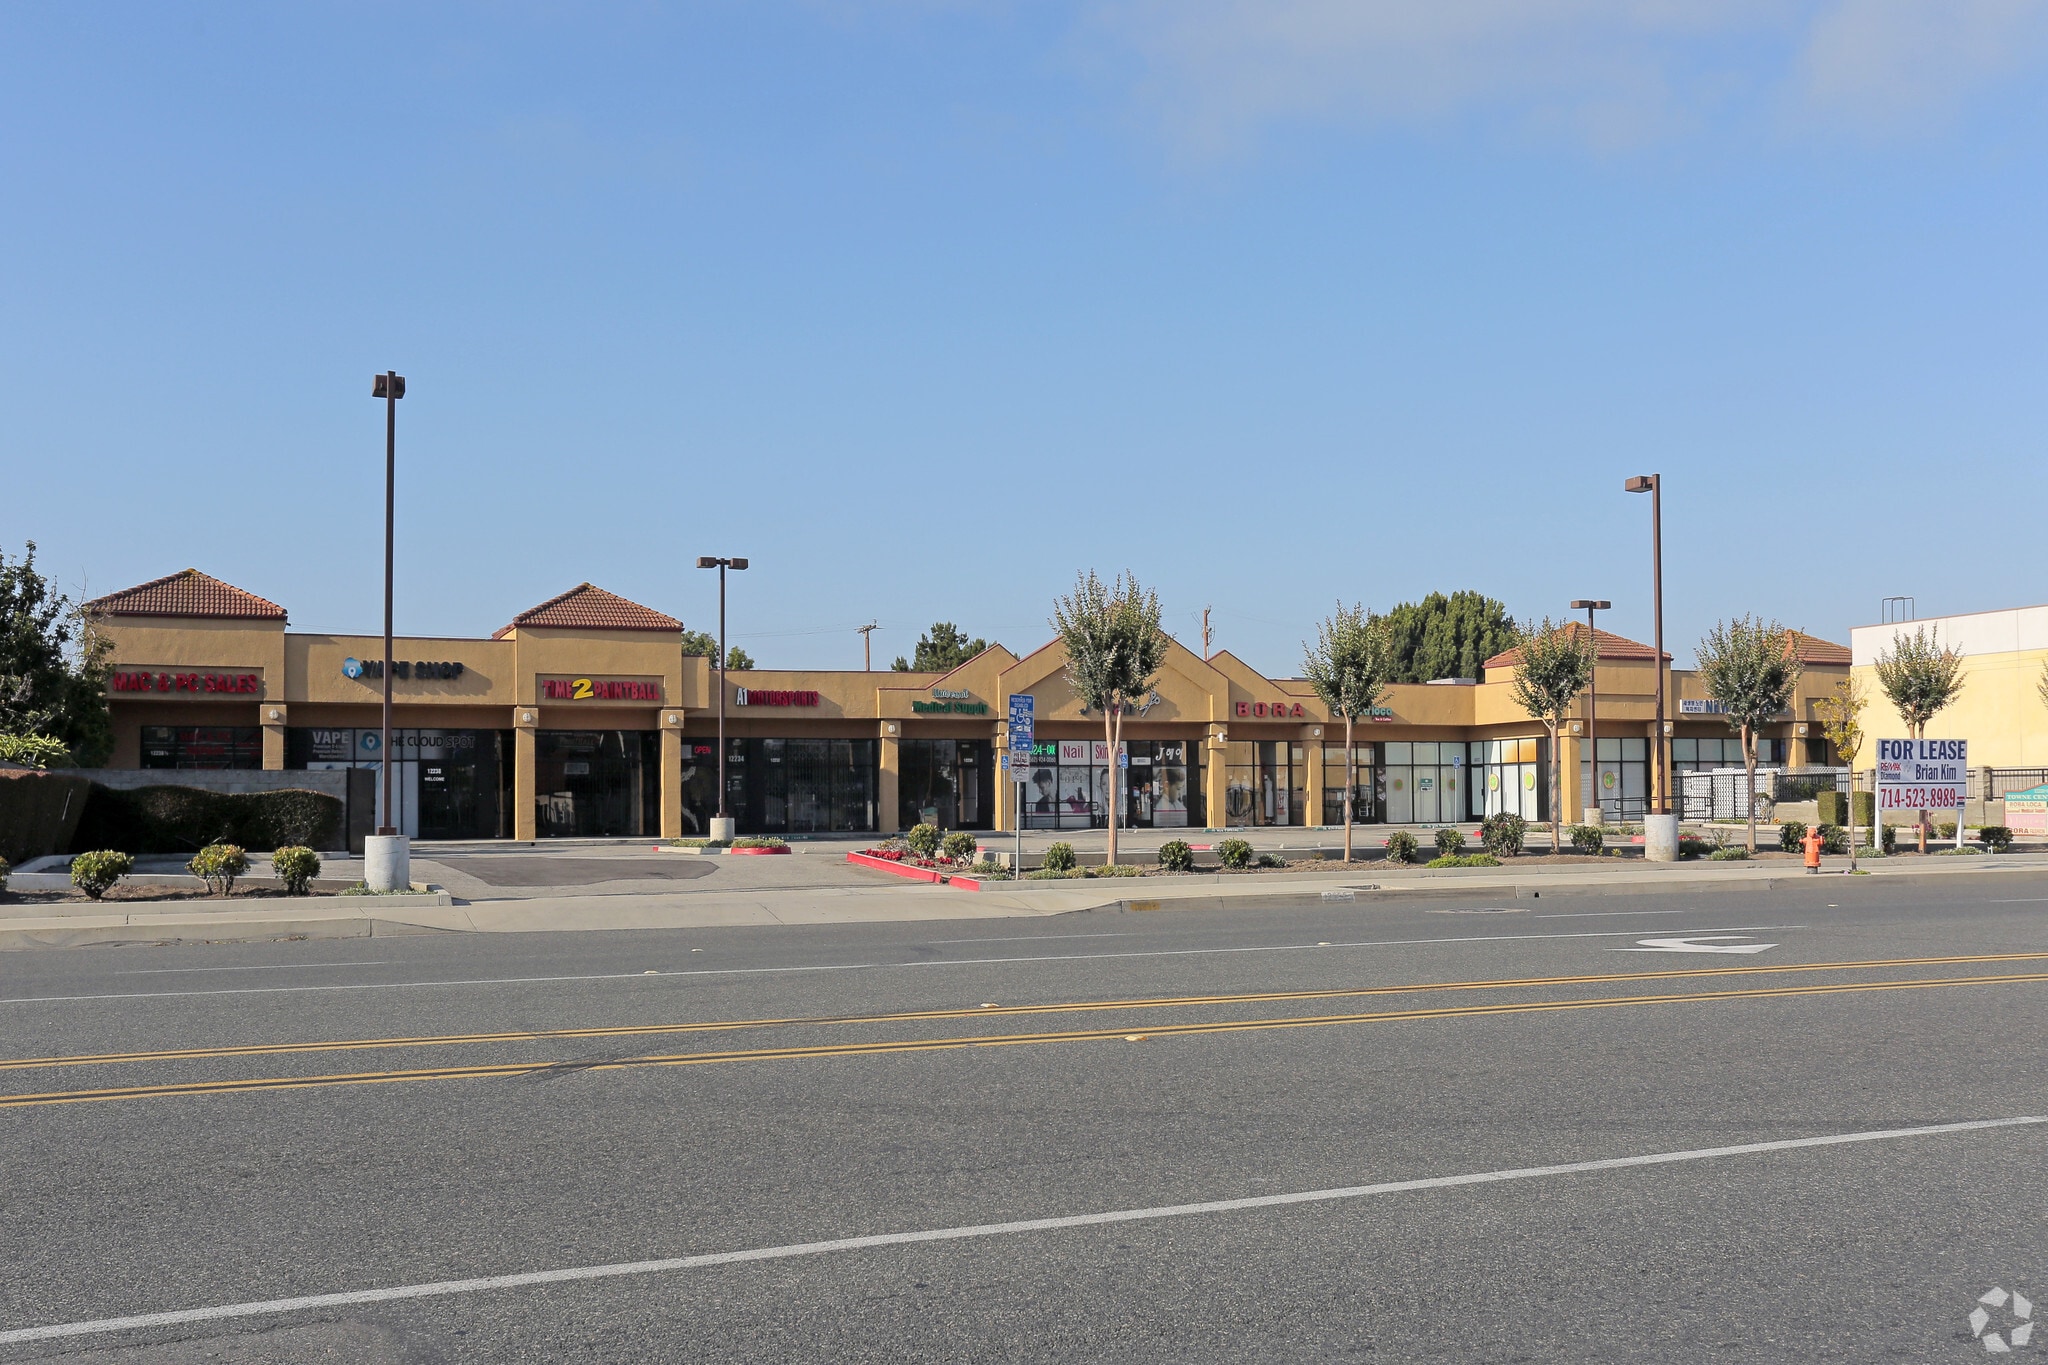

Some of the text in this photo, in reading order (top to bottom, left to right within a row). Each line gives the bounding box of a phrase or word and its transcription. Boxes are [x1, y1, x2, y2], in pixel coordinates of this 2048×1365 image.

[415, 661, 463, 680] SHOP
[113, 672, 257, 693] MAC & PC SALES
[543, 679, 659, 700] TIME 2 PAINTBALL
[736, 688, 819, 706] A1 MOTORSPORTS
[912, 701, 988, 715] Medical Supply
[1236, 702, 1305, 718] BORA
[312, 731, 349, 744] VAPE
[391, 736, 475, 748] HE CLOUD SPOT
[1064, 746, 1083, 758] Nail
[1096, 744, 1108, 759] Skin
[1881, 740, 1966, 760] FOR LEASE
[1880, 762, 1902, 772] RE/MAX
[1916, 764, 1956, 780] Brian Kim
[1880, 772, 1900, 780] Diamond
[1880, 788, 1956, 808] 714-523-8989
